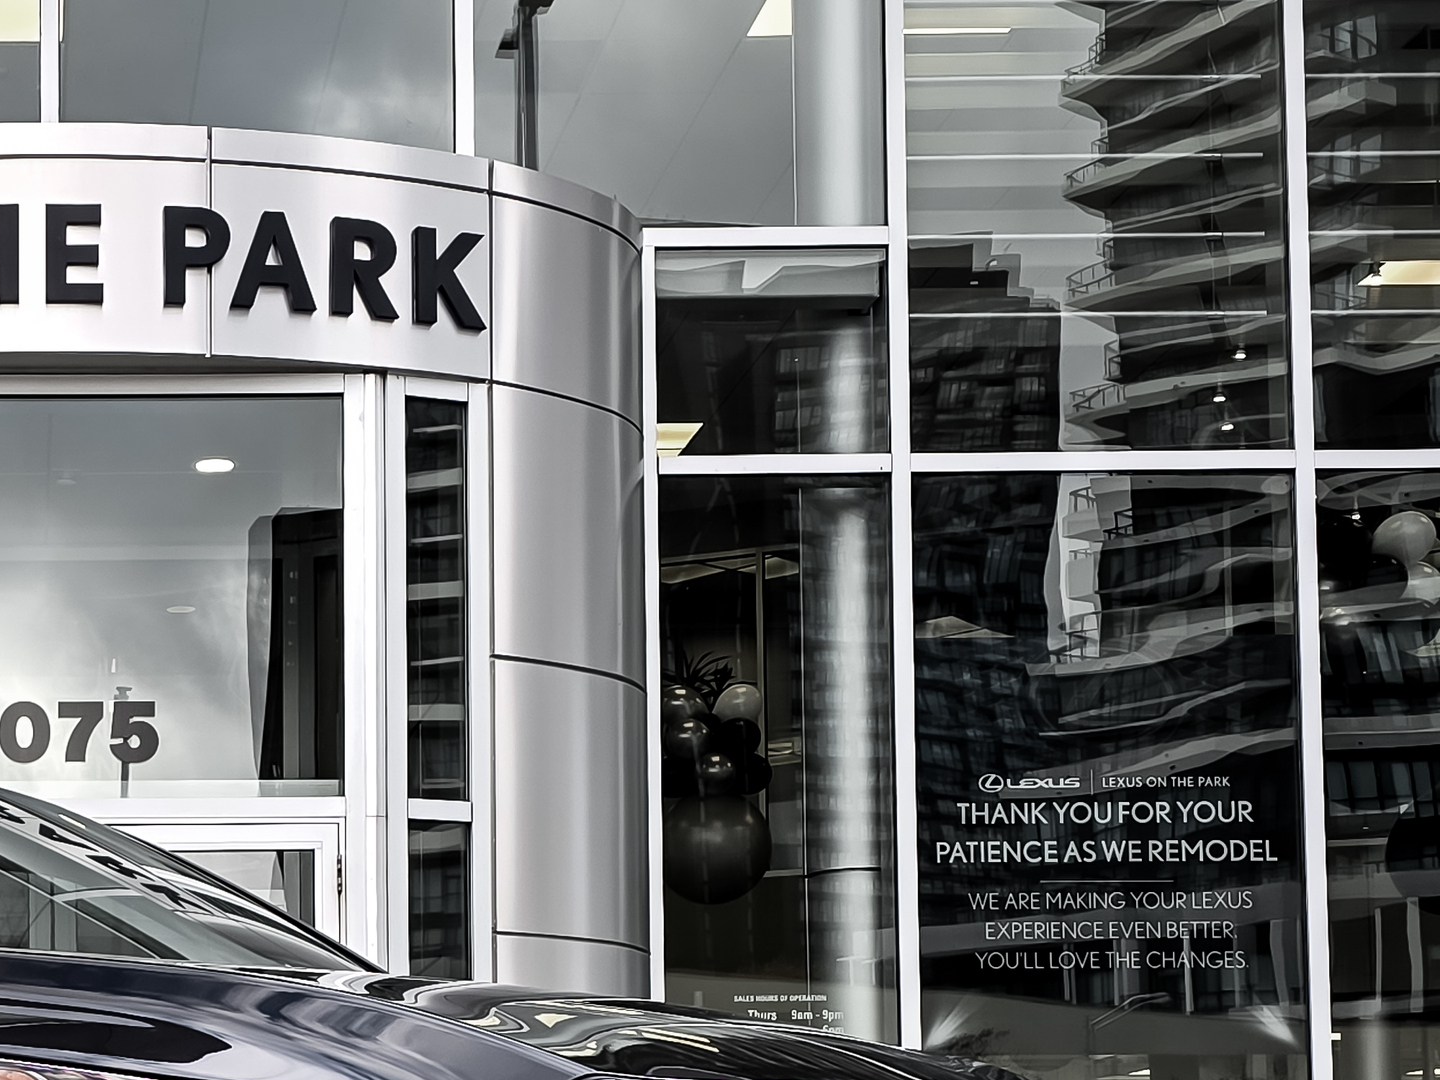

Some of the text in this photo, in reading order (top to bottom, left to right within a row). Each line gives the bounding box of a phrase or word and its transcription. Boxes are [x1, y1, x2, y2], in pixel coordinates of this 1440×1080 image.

[162, 205, 488, 332] PARK
[1005, 774, 1081, 790] LEXUS
[1101, 775, 1231, 788] LEXUS ON THE PARK
[956, 800, 1255, 825] THANK YOU FOR YOUR
[936, 839, 1278, 864] PATIENCE AS WE REMODEL
[968, 891, 1253, 910] WE ARE MAKING YOUR LEXUS
[985, 921, 1238, 939] EXPERIENCE EVEN BETTER.
[974, 950, 1250, 969] YOU'LL LOVE THE CHANGES.
[791, 1009, 814, 1020] 9am
[822, 1009, 845, 1022] 9pm
